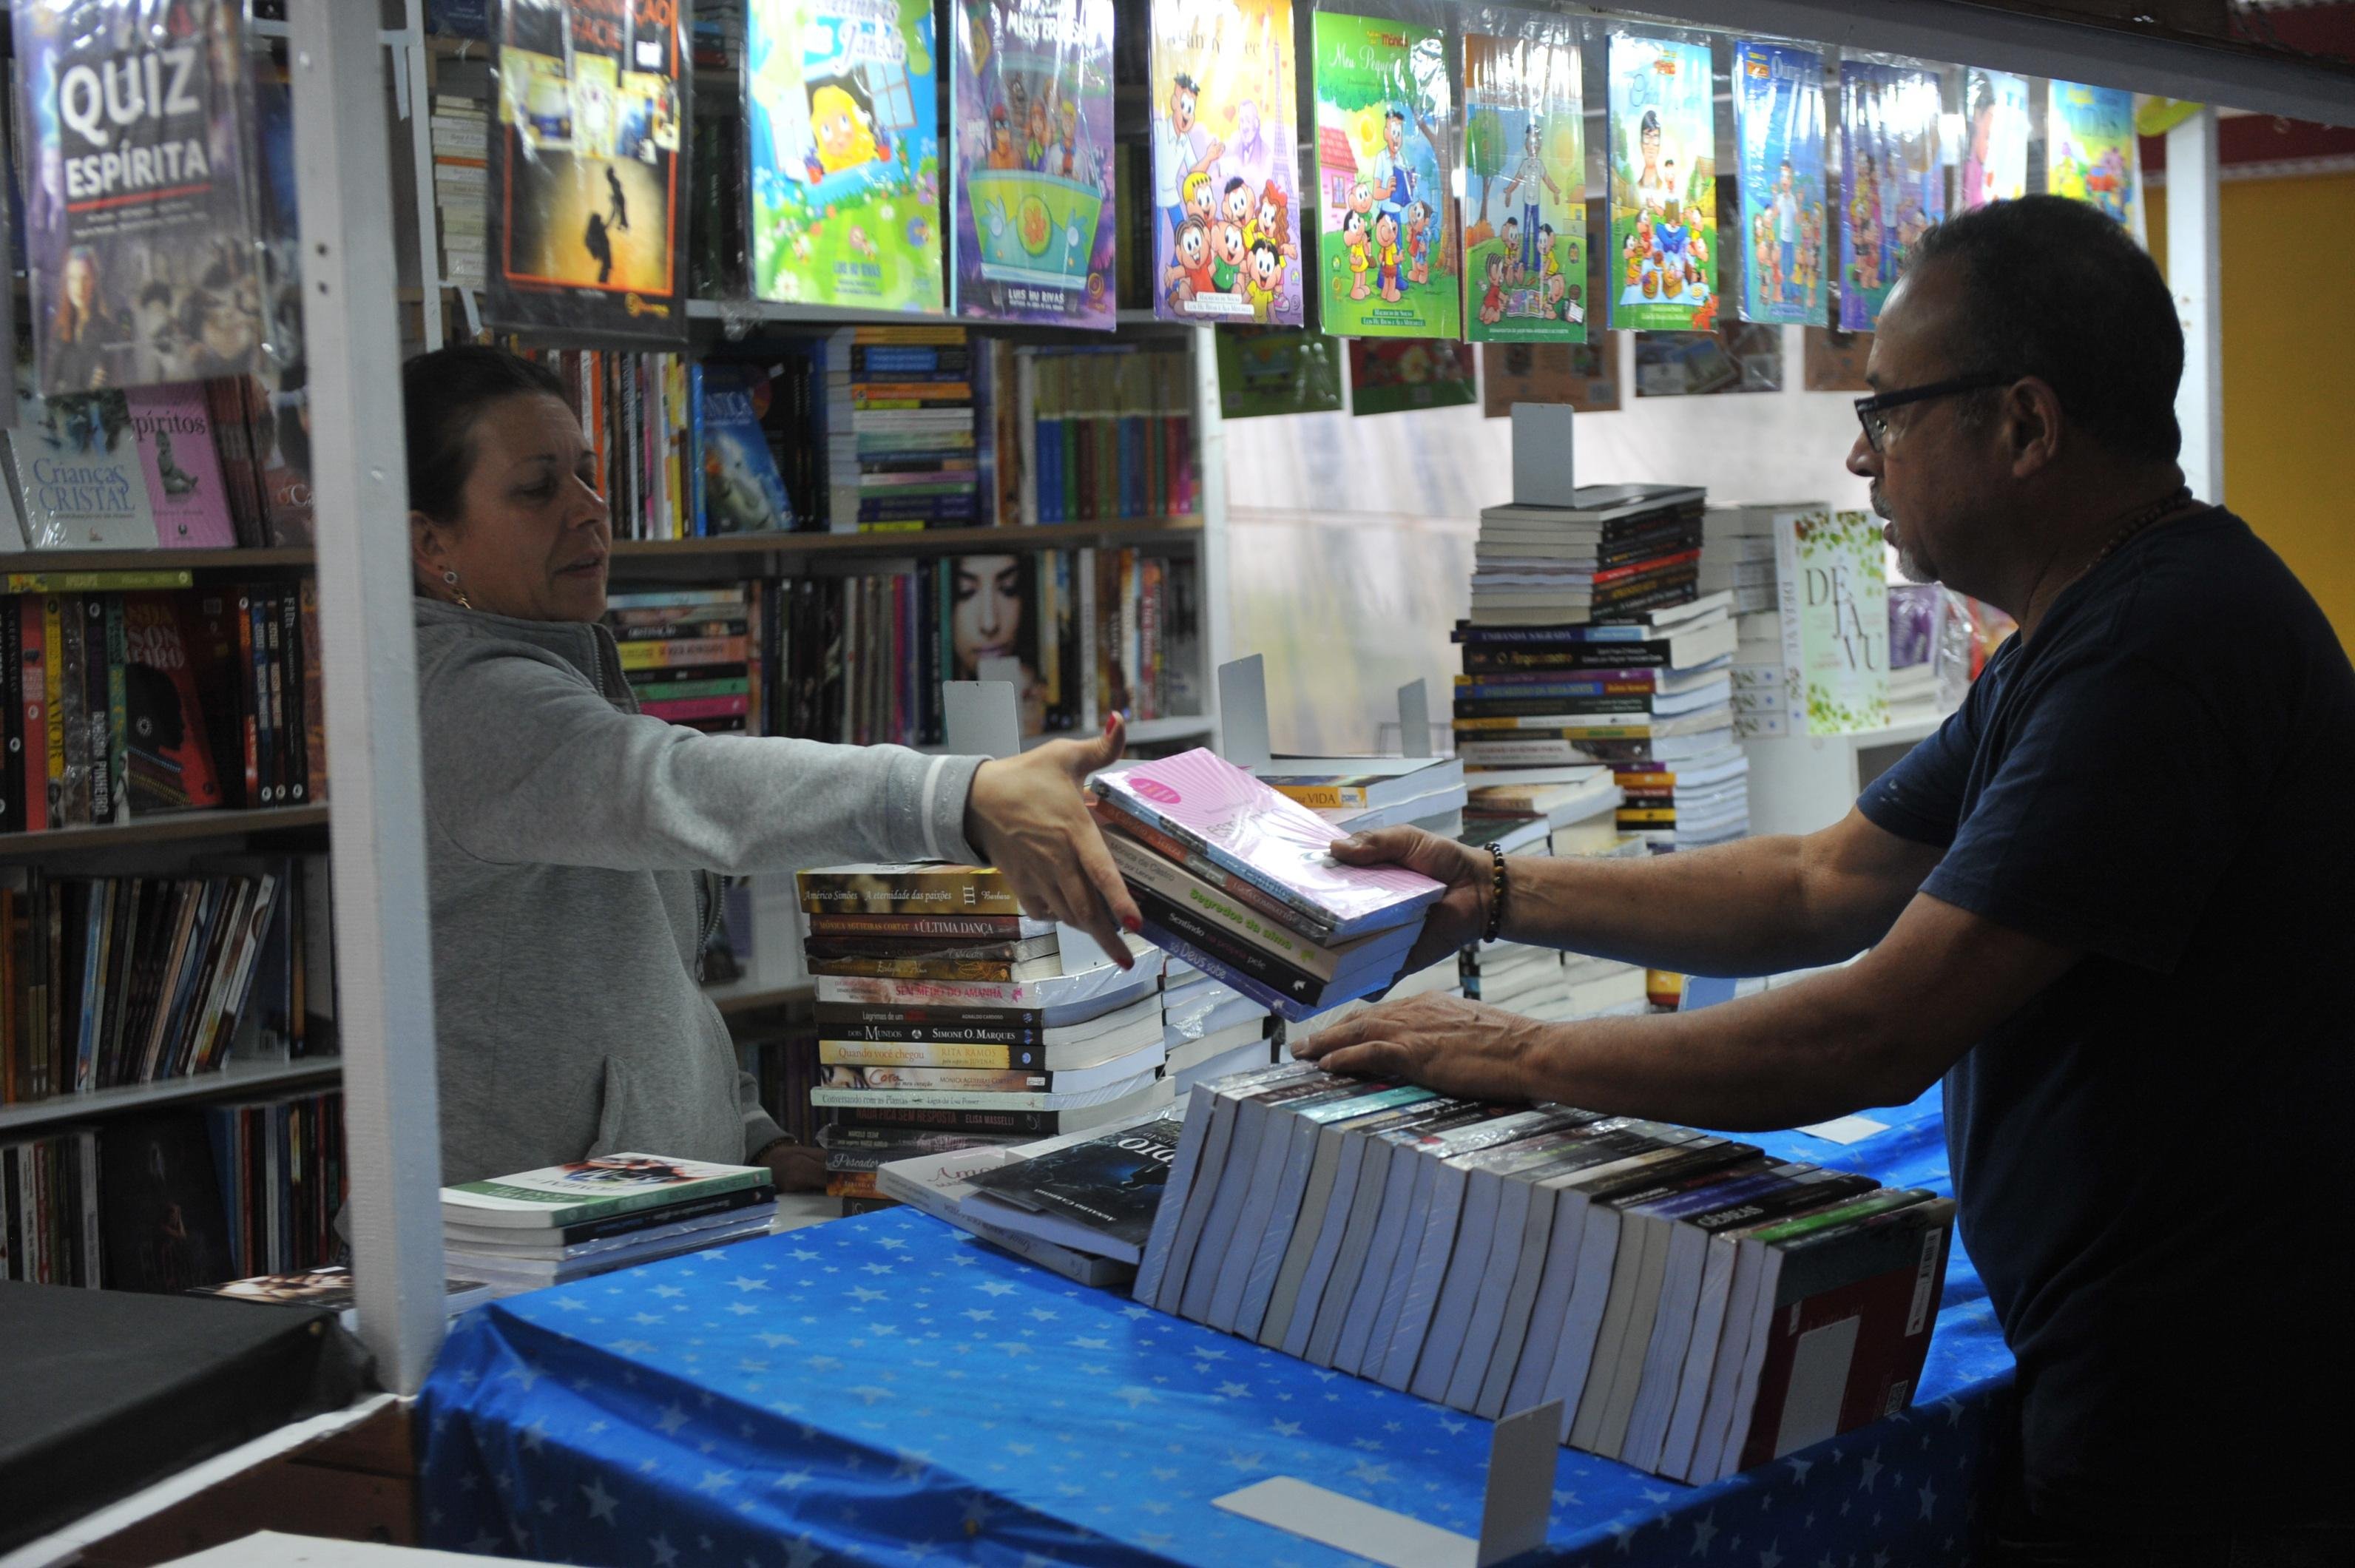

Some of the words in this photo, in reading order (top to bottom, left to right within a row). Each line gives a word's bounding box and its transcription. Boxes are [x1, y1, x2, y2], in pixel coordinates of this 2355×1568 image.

[61, 47, 200, 146] QUIZ
[66, 138, 208, 197] ESPÍRITA
[1008, 288, 1026, 300] LUIS
[1041, 291, 1065, 304] RIVAS
[132, 410, 206, 442] píritos
[33, 458, 129, 494] Crianças
[38, 484, 135, 512] CRISTAL
[94, 760, 109, 815] PINHEIRO
[1307, 792, 1337, 805] VIDA
[1148, 862, 1176, 882] Castro
[803, 890, 833, 901] Américo
[833, 890, 858, 900] Simões
[873, 889, 909, 900] eternidade
[910, 889, 924, 899] das
[925, 890, 952, 903] paixões
[921, 919, 958, 933] ÚLTIMA
[961, 922, 994, 936] DANÇA
[1189, 888, 1243, 924] Segredos
[1245, 919, 1261, 933] da
[1263, 927, 1292, 950] alma
[1169, 912, 1205, 937] Sentindo
[1247, 955, 1266, 970] pele
[1181, 942, 1206, 967] Deus
[1206, 963, 1228, 980] sabe
[896, 985, 913, 996] SEM
[947, 988, 961, 997] DO
[964, 986, 1003, 998] AMANHÃ
[888, 1012, 895, 1021] de
[865, 1025, 902, 1041] MUNDOS
[932, 1027, 962, 1039] SIMONE
[964, 1028, 976, 1039] O.
[976, 1029, 1016, 1041] MARQUES
[839, 1047, 873, 1058] Quando
[874, 1049, 893, 1058] você
[895, 1049, 925, 1061] chegou
[941, 1047, 962, 1056] RITA
[964, 1048, 996, 1058] RAMOS
[869, 1069, 903, 1085] Cora
[822, 1095, 862, 1104] Conversando
[885, 1095, 908, 1105] Plantas
[898, 1110, 916, 1121] SEM
[917, 1111, 957, 1124] RESPOSTA
[965, 1115, 983, 1123] ELISA
[984, 1115, 1014, 1126] MASSELLI
[1118, 1137, 1177, 1163] DIO
[833, 1153, 888, 1168] Pescador
